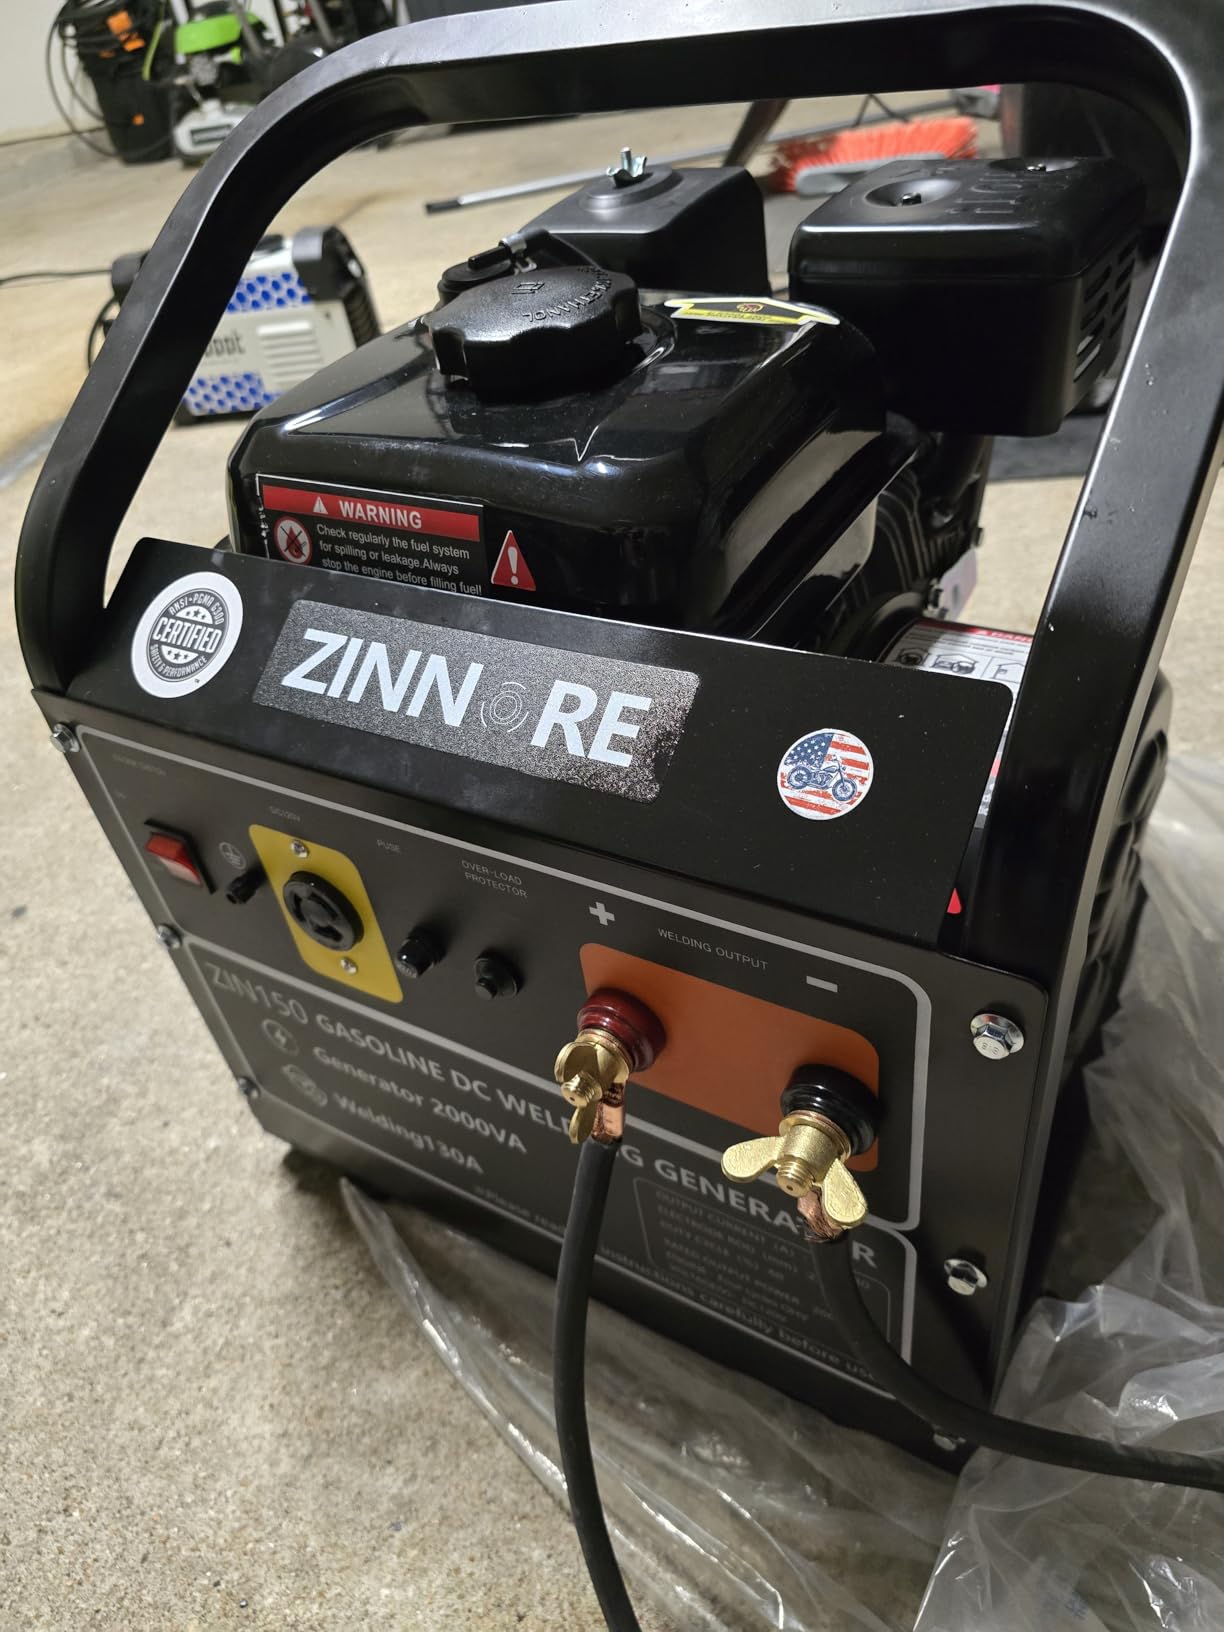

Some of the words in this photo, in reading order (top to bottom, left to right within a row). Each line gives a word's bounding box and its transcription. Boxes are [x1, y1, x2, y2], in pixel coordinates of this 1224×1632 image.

[339, 500, 422, 529] WARNING
[316, 523, 347, 539] Check
[349, 530, 389, 549] regularly
[392, 534, 408, 549] the
[410, 536, 430, 553] fuel
[432, 544, 470, 560] system
[319, 540, 332, 552] for
[334, 542, 367, 560] spilling
[369, 551, 379, 561] or
[322, 557, 342, 571] stop
[344, 559, 359, 573] the
[361, 565, 394, 580] engine
[396, 569, 428, 586] before
[430, 575, 457, 593] filling
[459, 580, 482, 596] fuel!
[152, 617, 222, 653] CERTIFIED
[161, 656, 207, 678] PERFORMANCE
[461, 860, 522, 886] OVER-LOAD
[464, 872, 528, 898] PROTECTOR
[657, 928, 712, 953] WELDING
[716, 946, 769, 971] OUTPUT
[205, 962, 309, 1025] ZIN150
[316, 1014, 445, 1082] GASOLINE
[451, 1069, 492, 1101] DC
[496, 1089, 644, 1168] WELG
[654, 1158, 877, 1268] GENERAR
[312, 1046, 424, 1106] Generator
[430, 1097, 527, 1153] 2000VA
[333, 1092, 484, 1174] Welding130A
[778, 1327, 840, 1365] before
